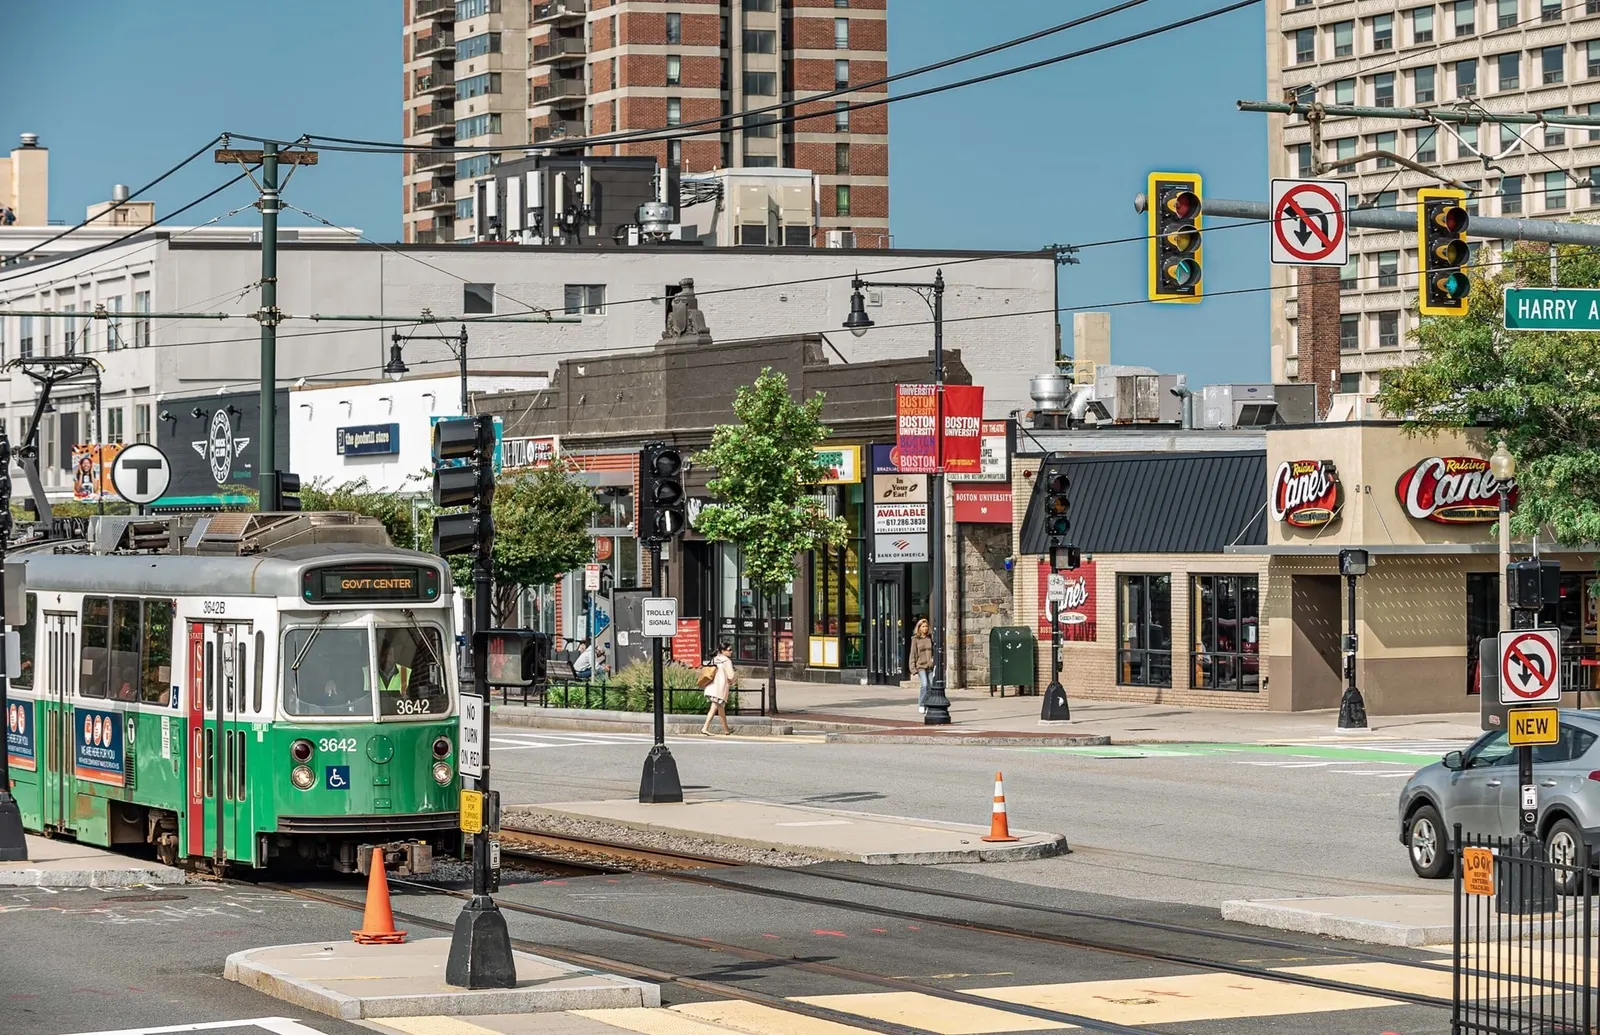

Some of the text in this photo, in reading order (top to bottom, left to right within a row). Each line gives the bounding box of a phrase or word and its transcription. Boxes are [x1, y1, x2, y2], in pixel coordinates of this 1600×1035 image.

[1518, 298, 1577, 320] HARRY
[900, 395, 936, 408] BOSTON
[899, 416, 936, 428] BOSTON
[945, 416, 980, 429] BOSTON
[900, 428, 936, 436] UNIVERSITY
[945, 428, 980, 437] UNIVERSITY
[900, 455, 936, 467] BOSTON
[1446, 459, 1486, 473] Raising
[122, 459, 162, 495] T
[892, 490, 908, 498] Ear!
[956, 493, 1012, 502] BOSTON UNIVERSITY
[1271, 460, 1330, 522] Cane's
[876, 508, 926, 518] AVAILABLE
[341, 579, 411, 590] GOV'T CENTER
[203, 601, 226, 614] 3642B
[396, 699, 430, 715] 3642
[466, 704, 476, 721] NO
[1515, 718, 1549, 735] NEW
[464, 726, 478, 744] TURN
[319, 738, 357, 752] 3642
[461, 749, 480, 767] ON RED
[467, 803, 475, 811] FOR
[1466, 855, 1491, 874] LOOK
